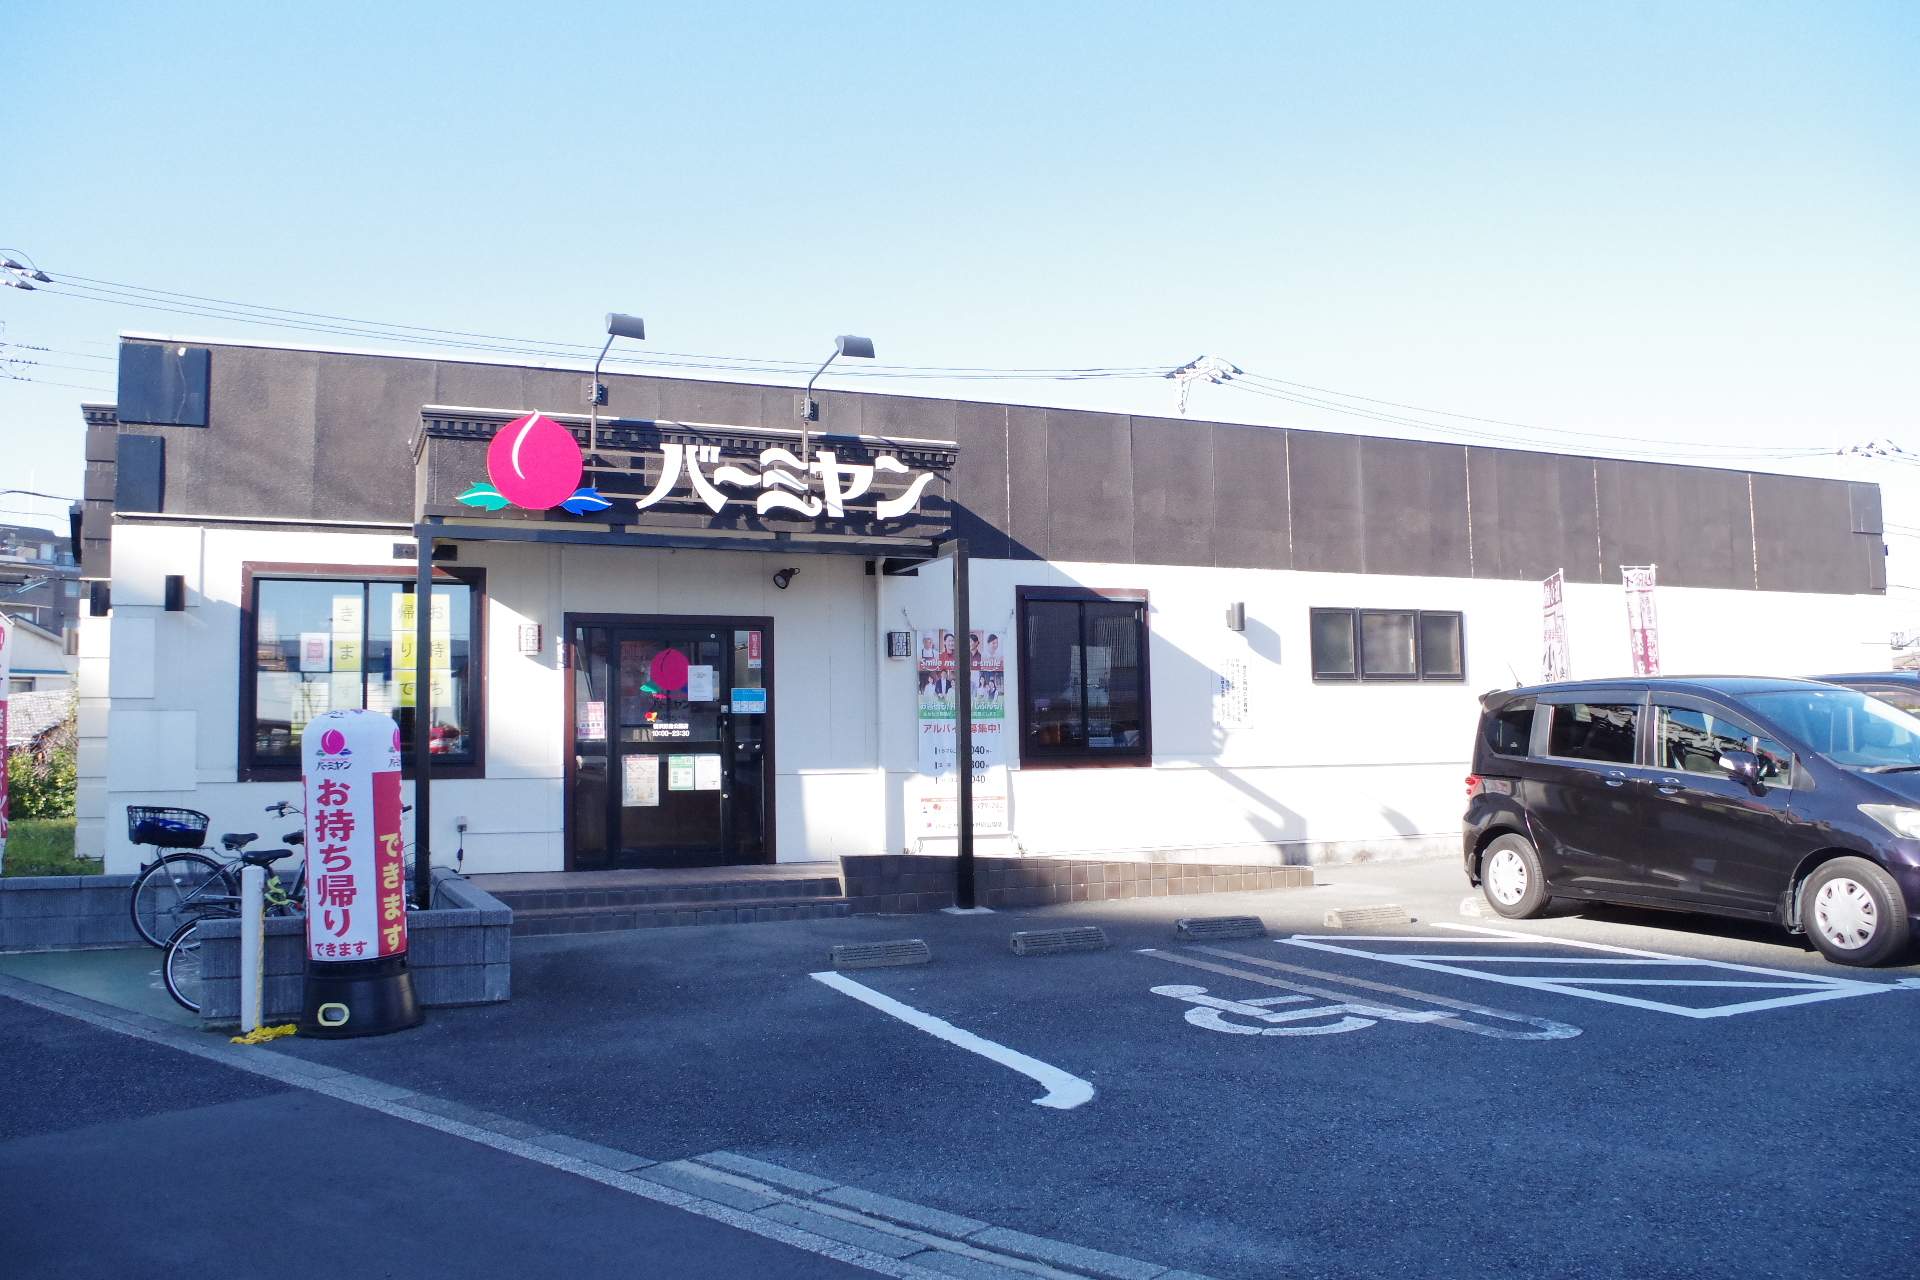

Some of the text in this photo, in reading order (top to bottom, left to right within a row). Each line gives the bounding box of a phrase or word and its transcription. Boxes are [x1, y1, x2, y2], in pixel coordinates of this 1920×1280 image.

[636, 443, 934, 520] バーミヤン
[920, 658, 943, 668] Smile
[316, 761, 352, 771] バーミヤン
[315, 778, 357, 937] お持ち帰り
[379, 832, 403, 953] できます
[314, 940, 368, 957] できます
